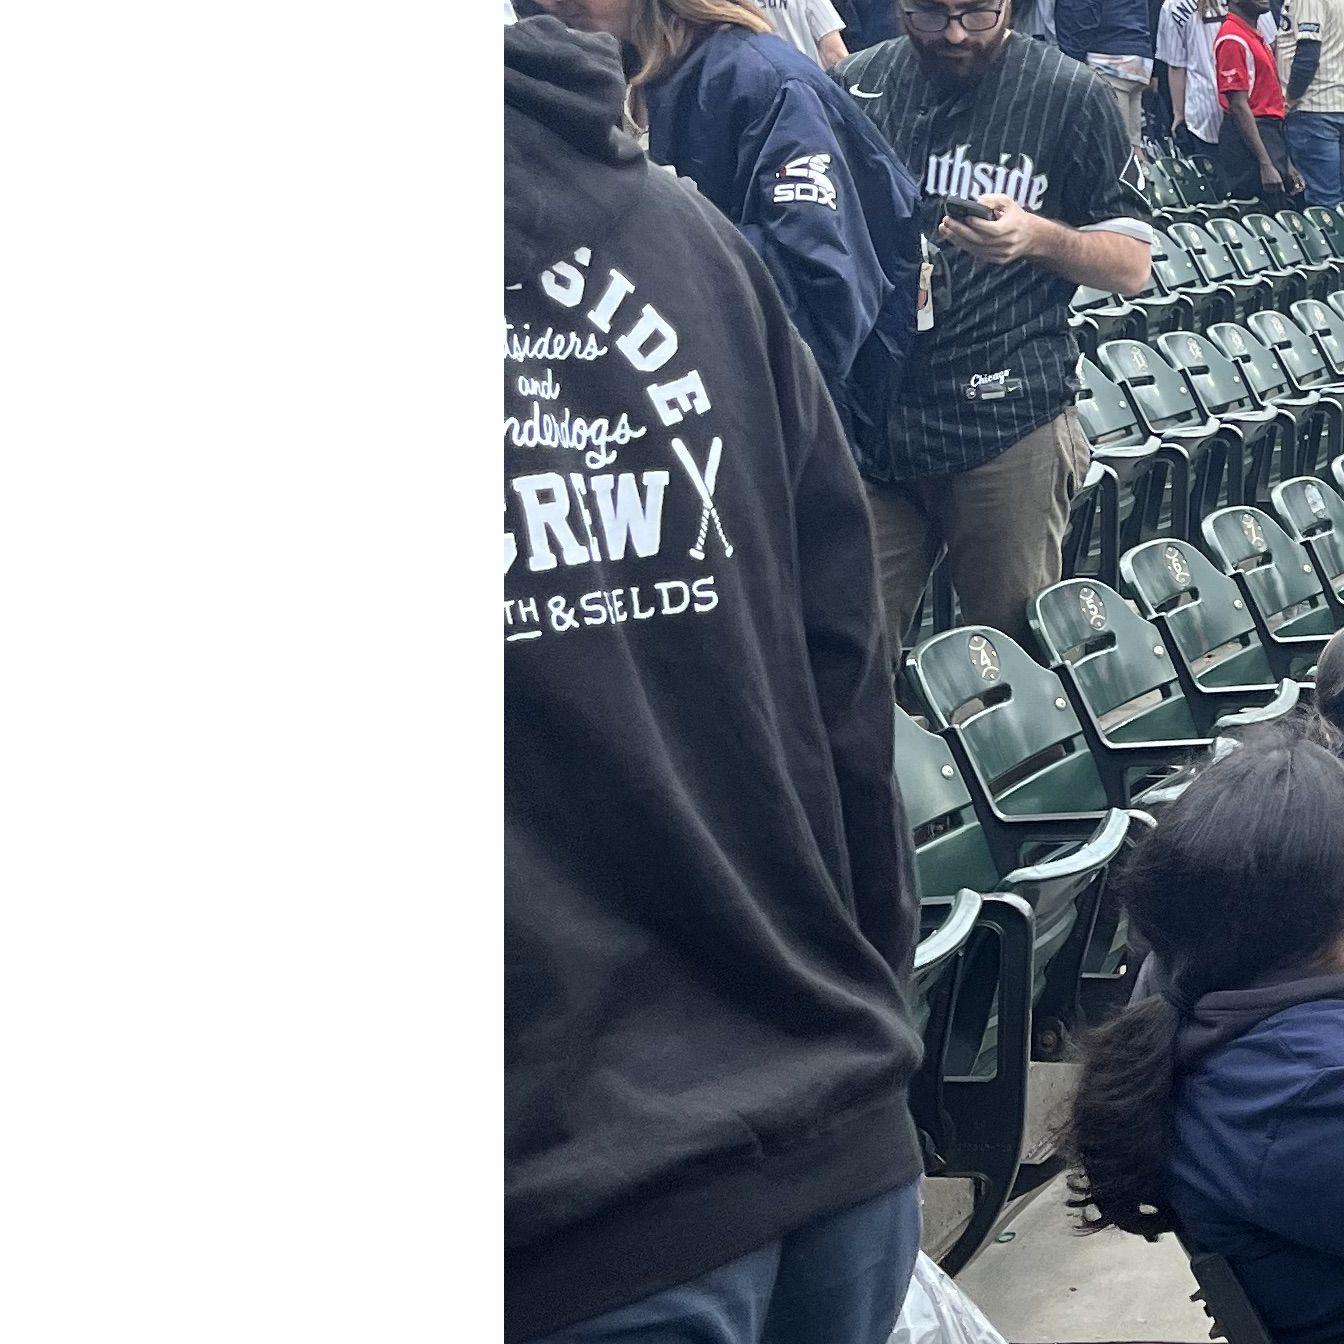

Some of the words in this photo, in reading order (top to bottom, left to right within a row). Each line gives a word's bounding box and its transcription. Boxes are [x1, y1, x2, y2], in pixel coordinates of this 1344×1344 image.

[772, 183, 838, 211] SOX
[518, 368, 561, 400] and
[970, 368, 1011, 388] Chicago
[547, 595, 580, 632] &
[1086, 598, 1099, 617] 5
[979, 648, 992, 668] 4
